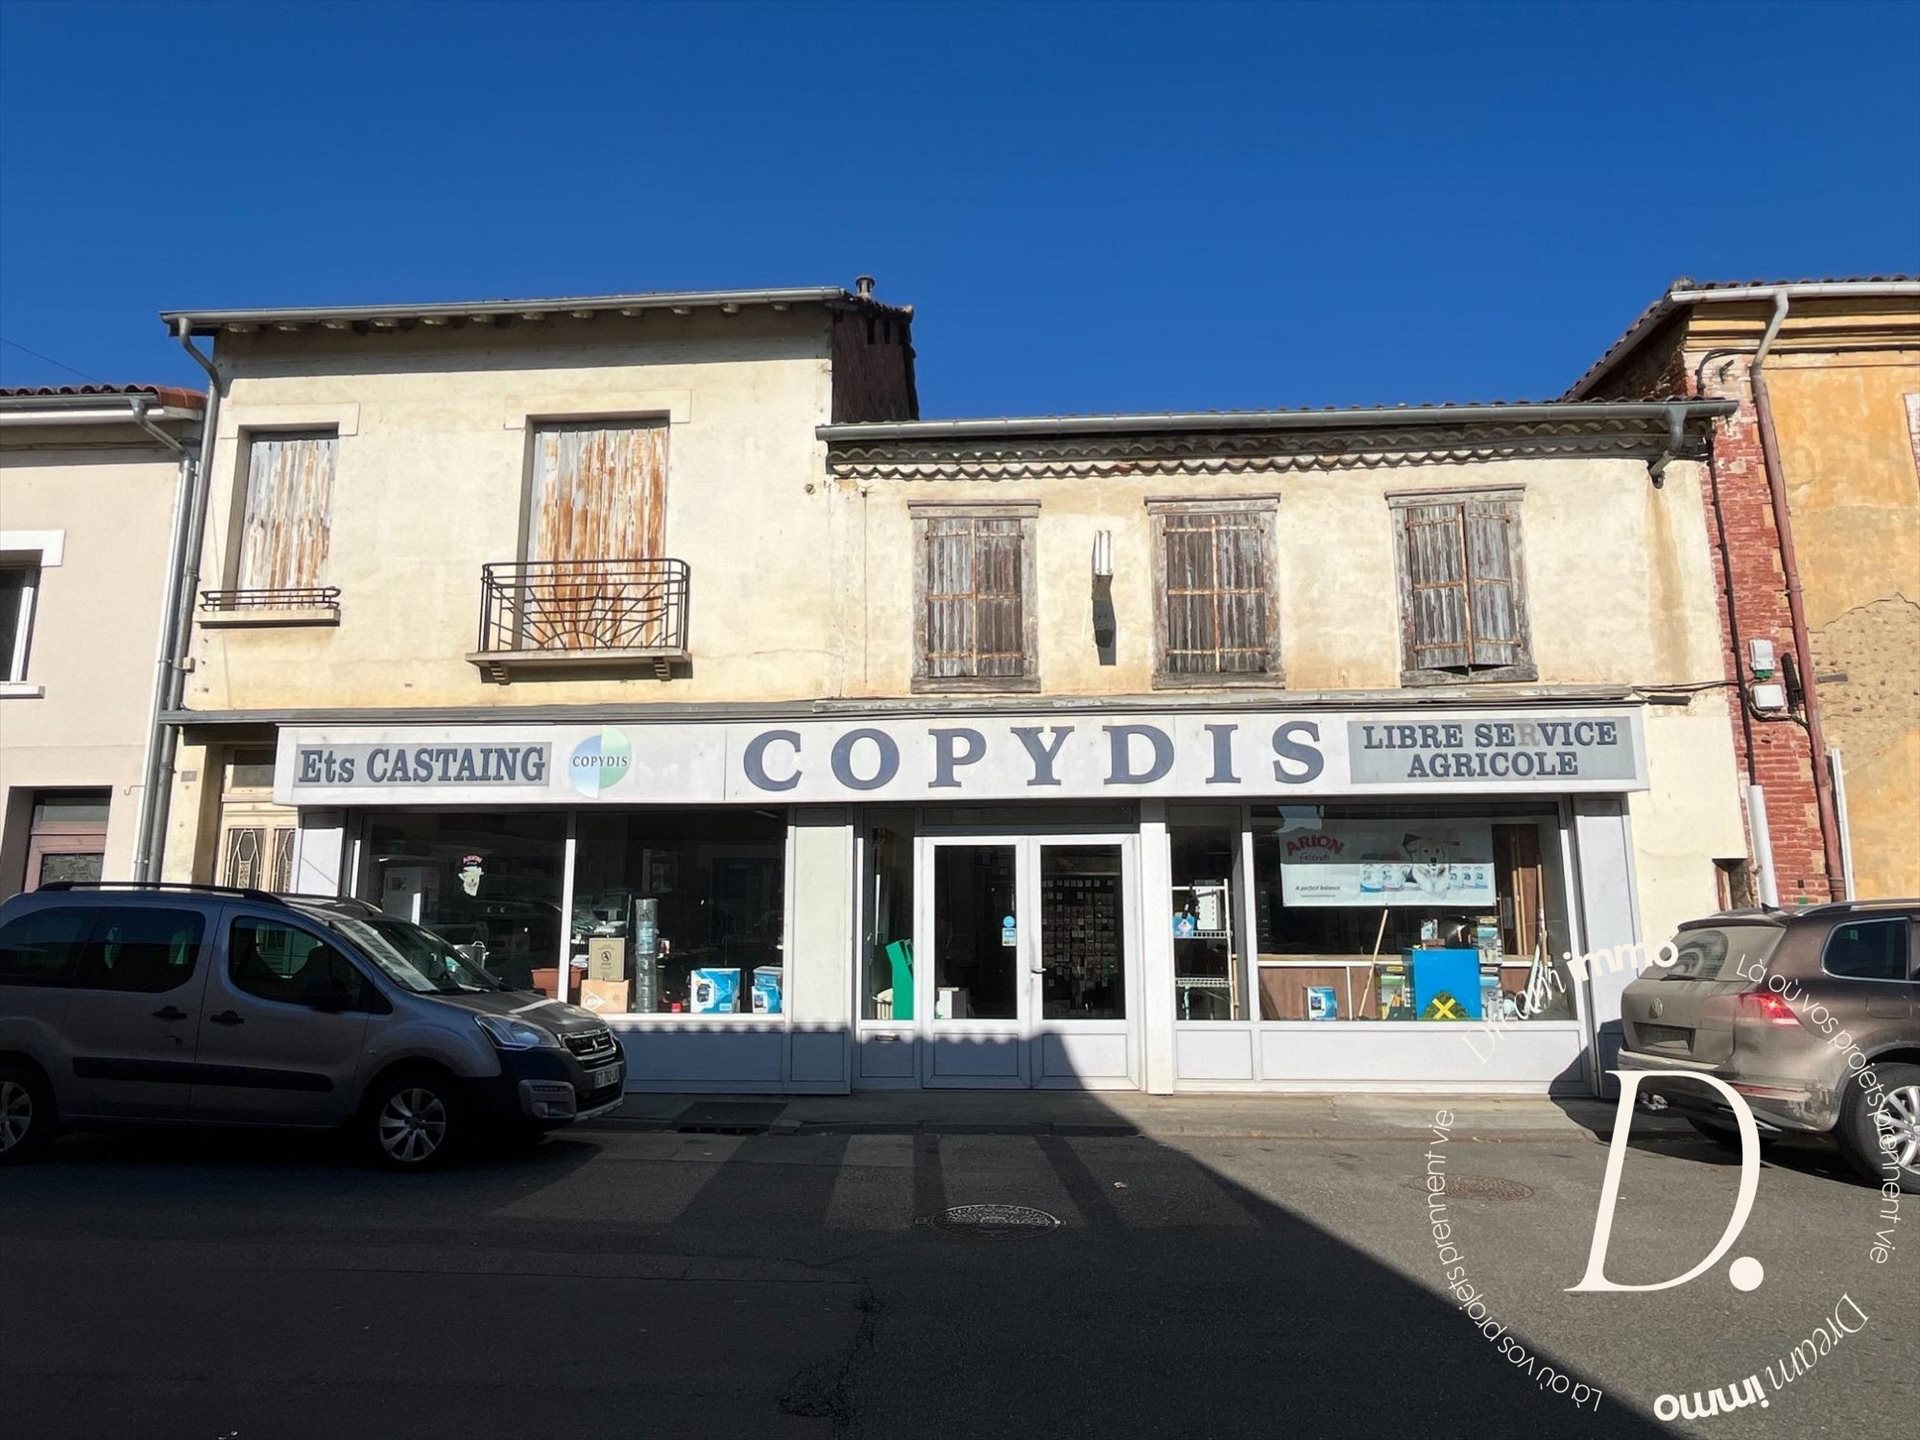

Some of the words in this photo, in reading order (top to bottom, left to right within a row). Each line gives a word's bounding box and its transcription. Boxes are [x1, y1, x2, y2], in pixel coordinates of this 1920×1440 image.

[1362, 724, 1463, 749] LIBRE
[1475, 721, 1618, 747] SERVICE
[298, 749, 355, 783] Ets
[366, 746, 546, 782] CASTAING
[572, 754, 629, 768] COPYDIS
[743, 720, 1325, 792] COPYDIS
[1407, 751, 1579, 778] AGRICOLE
[1285, 834, 1345, 857] ARION
